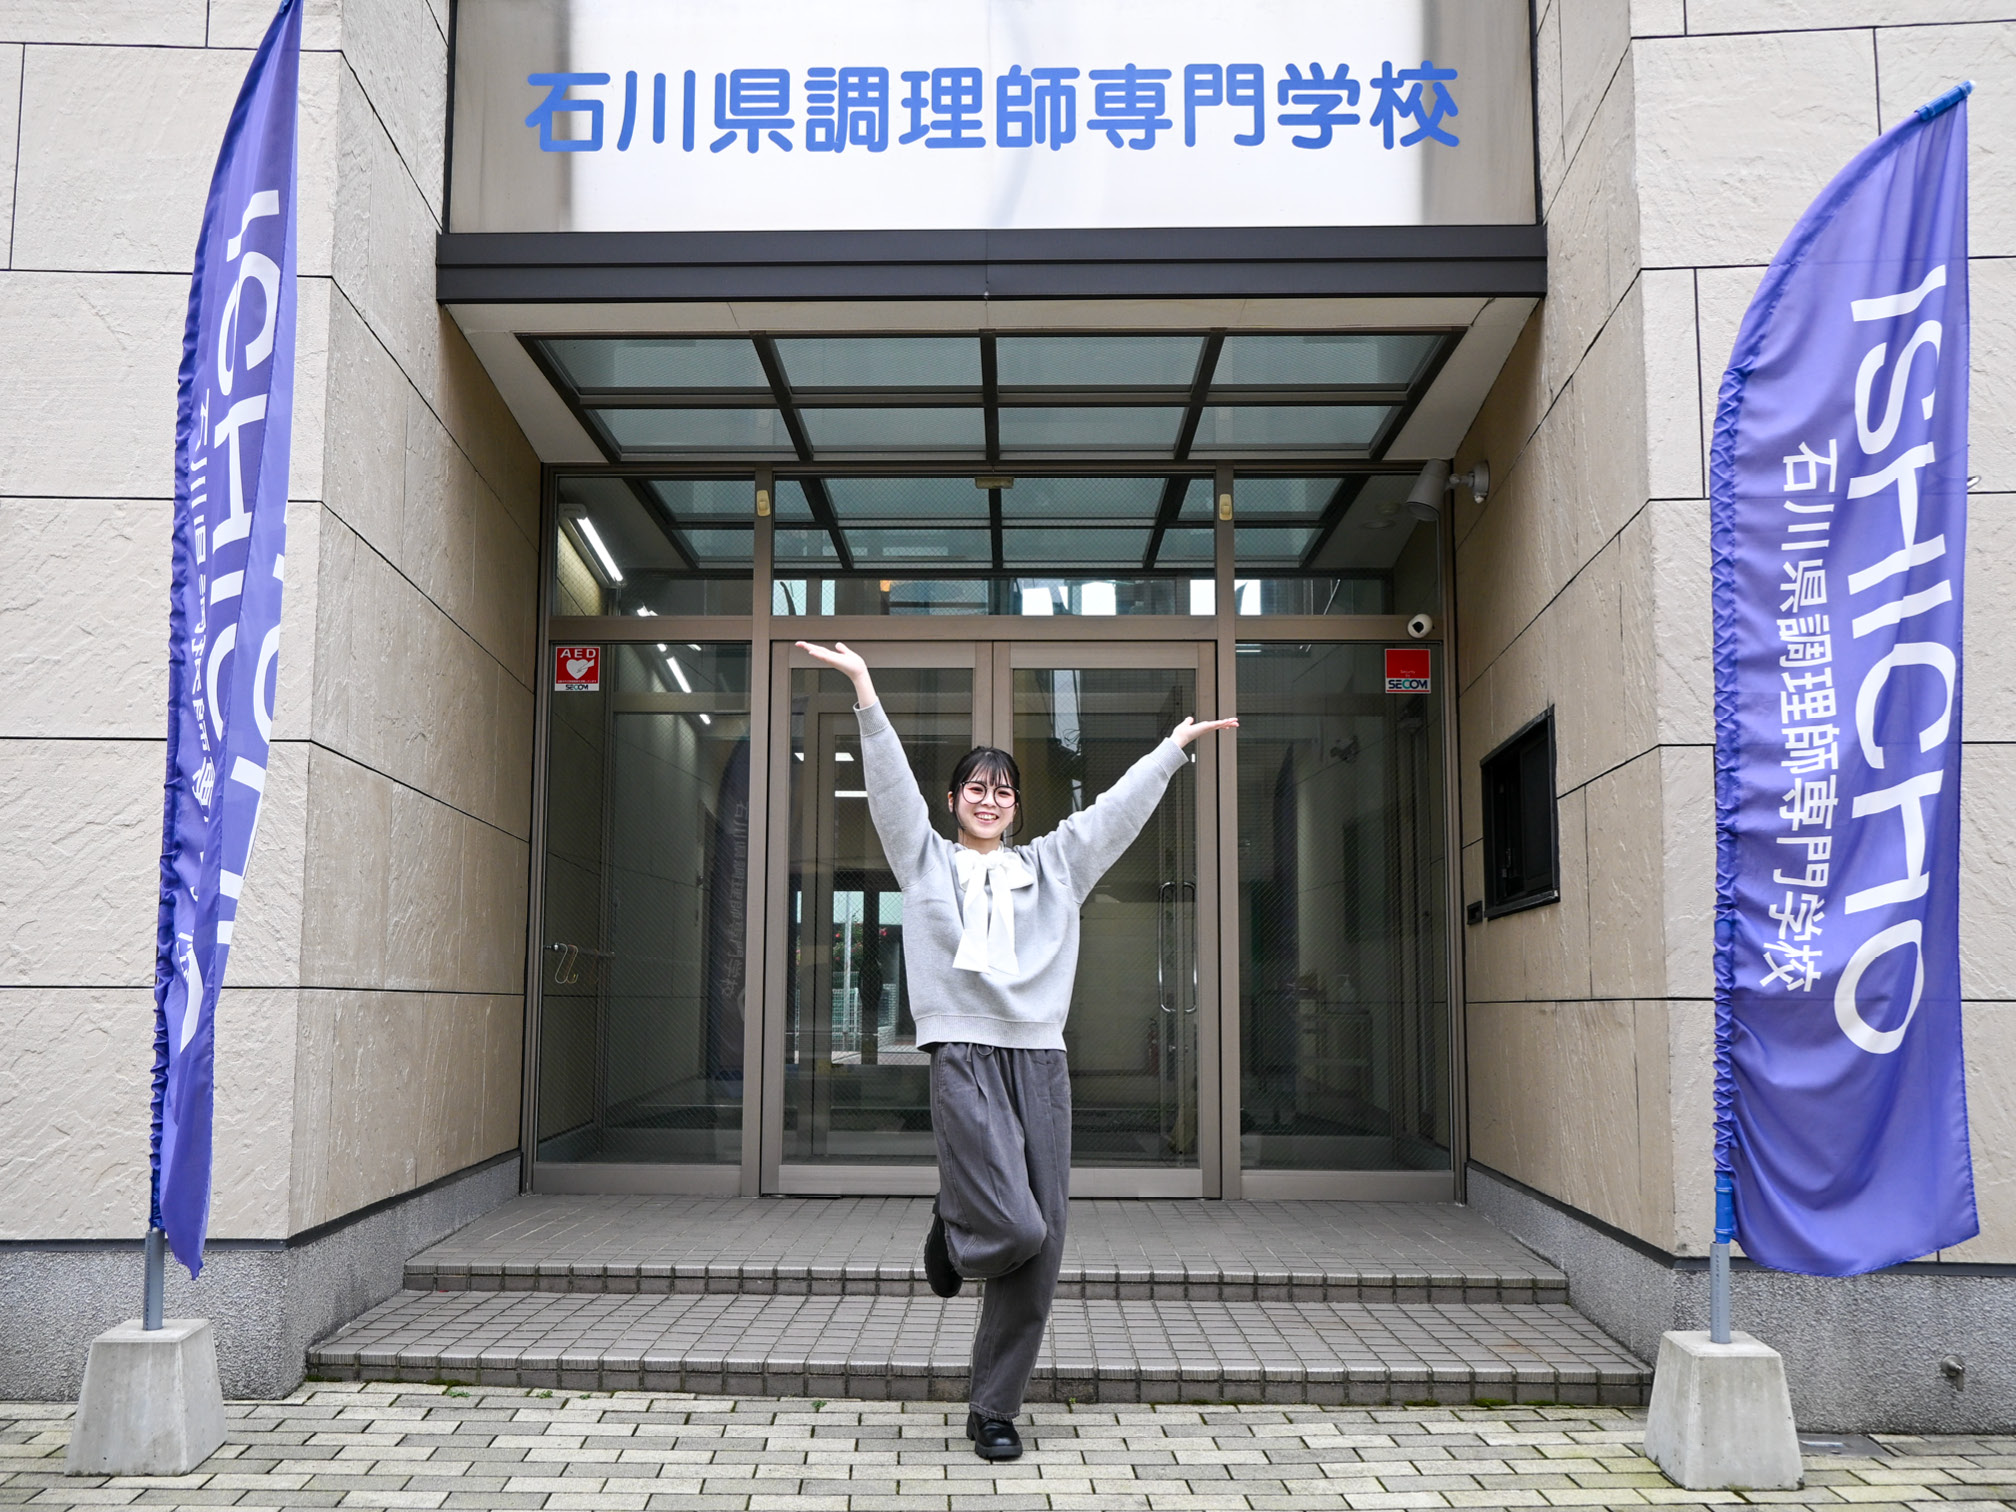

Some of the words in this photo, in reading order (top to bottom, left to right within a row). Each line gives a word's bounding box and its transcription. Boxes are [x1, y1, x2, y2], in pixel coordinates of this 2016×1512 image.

[525, 60, 1460, 154] 石川県調理師専門学校
[560, 648, 596, 658] AED
[1388, 679, 1428, 689] SECOM
[1833, 264, 1957, 1054] ISHICHO
[1759, 438, 1839, 993] 石川県調理師専門学校
